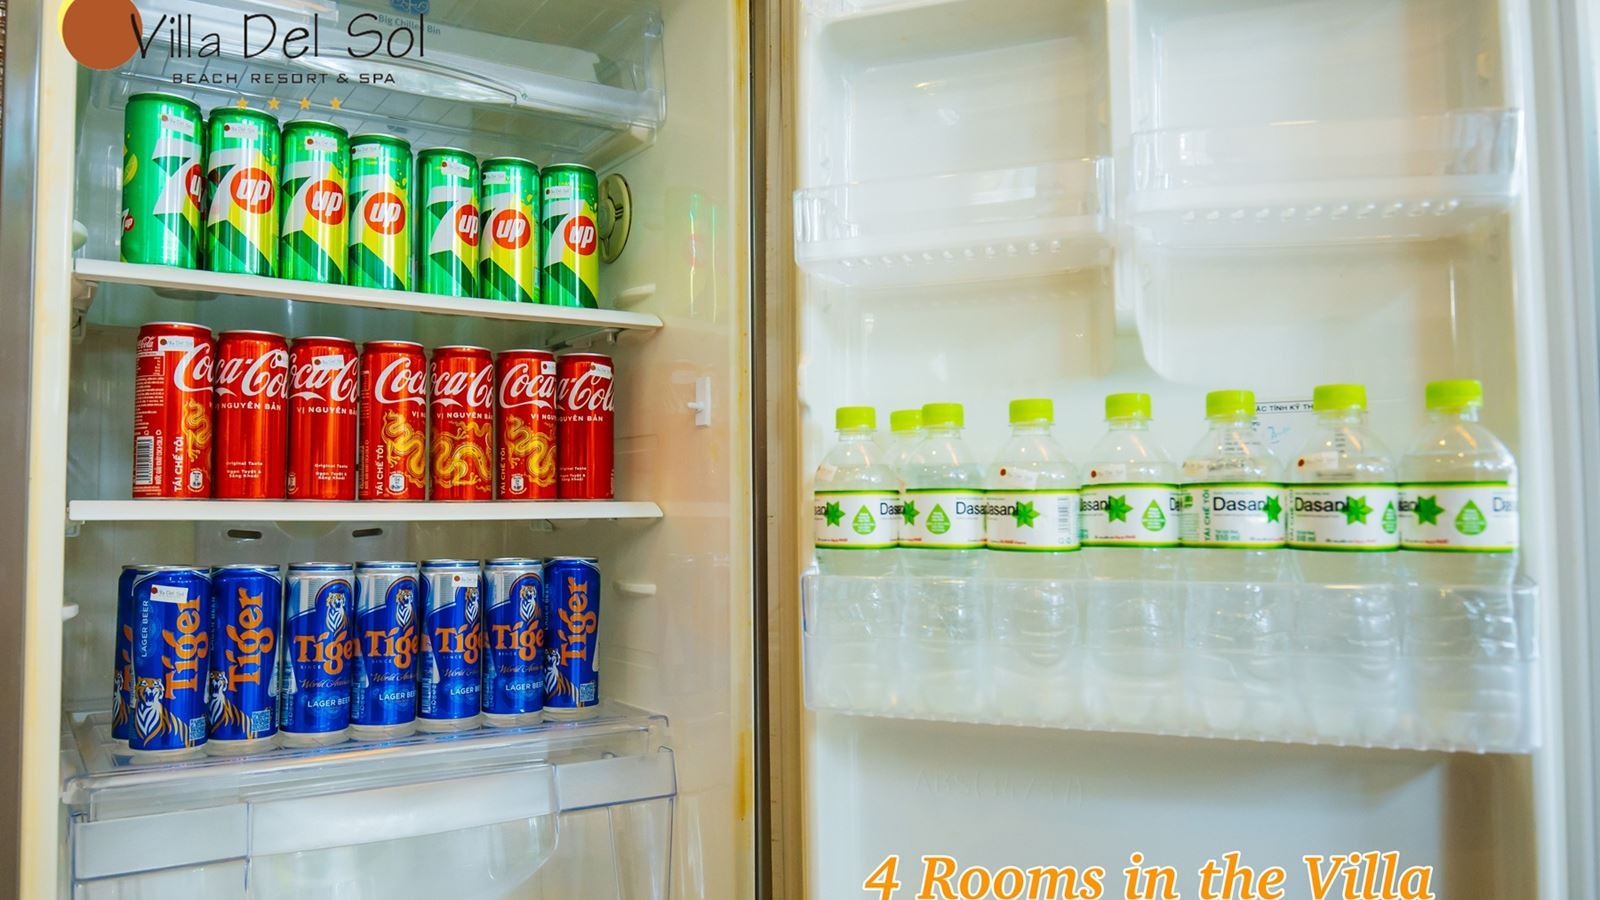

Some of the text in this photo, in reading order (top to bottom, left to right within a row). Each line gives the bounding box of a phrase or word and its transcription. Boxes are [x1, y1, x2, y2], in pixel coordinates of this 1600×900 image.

[378, 14, 441, 36] Big Chille Bin
[1213, 496, 1266, 512] Dasan
[141, 600, 149, 658] LAGER BEER
[450, 686, 474, 696] LAGER
[505, 683, 531, 691] LAGER
[379, 692, 406, 701] LAGER
[307, 699, 337, 708] LAGER
